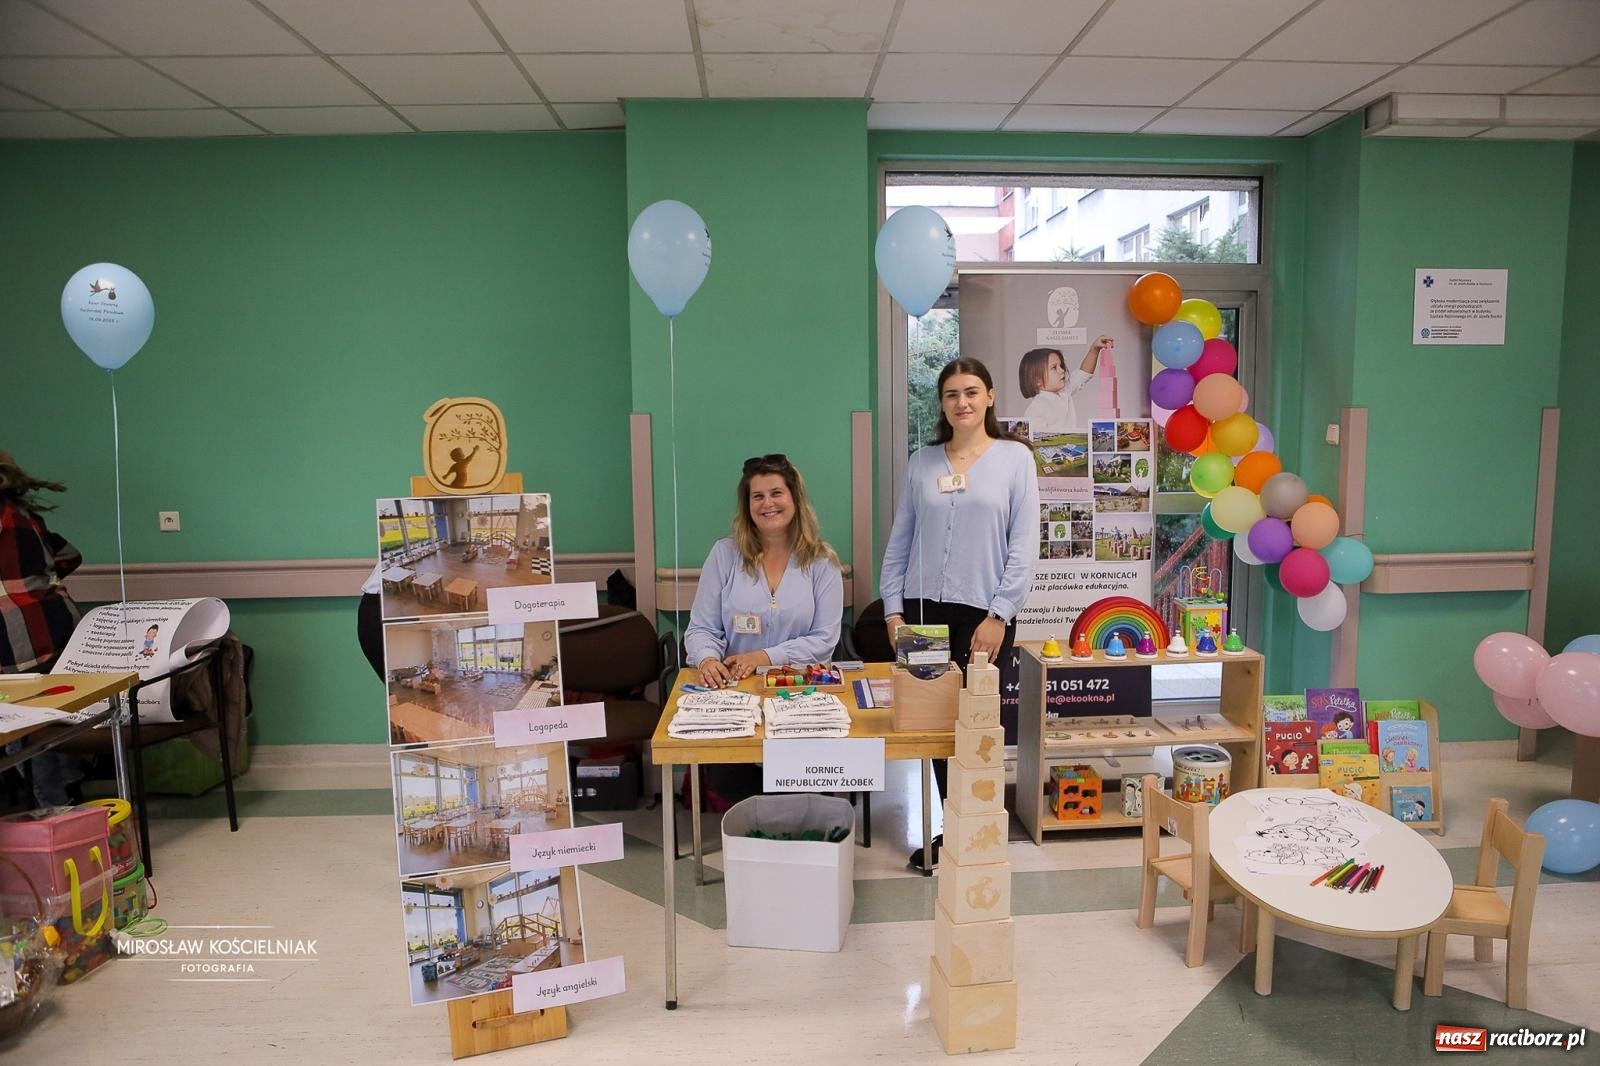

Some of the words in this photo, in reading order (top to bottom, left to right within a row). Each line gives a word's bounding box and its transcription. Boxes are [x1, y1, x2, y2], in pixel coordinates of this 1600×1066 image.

[1035, 572, 1048, 580] SZE
[1050, 572, 1075, 580] DZIECI
[1080, 572, 1088, 580] W
[1090, 572, 1137, 580] KORNICACH
[1047, 583, 1083, 592] placówka
[1085, 583, 1129, 592] edukacyjna.
[514, 598, 566, 612] Dogoterapia
[1020, 606, 1050, 614] rozwoju
[1060, 680, 1083, 691] 051
[1086, 679, 1109, 690] 472
[529, 720, 568, 734] Logopeda
[1275, 732, 1303, 740] PUCIO
[805, 766, 845, 774] KORNICE
[775, 779, 838, 787] NIEPUBLICZNY
[840, 777, 874, 786] ŻŁOBEK
[531, 846, 556, 860] Język
[558, 843, 596, 855] niemiecki
[536, 984, 561, 998] Język
[562, 977, 598, 994] angielski
